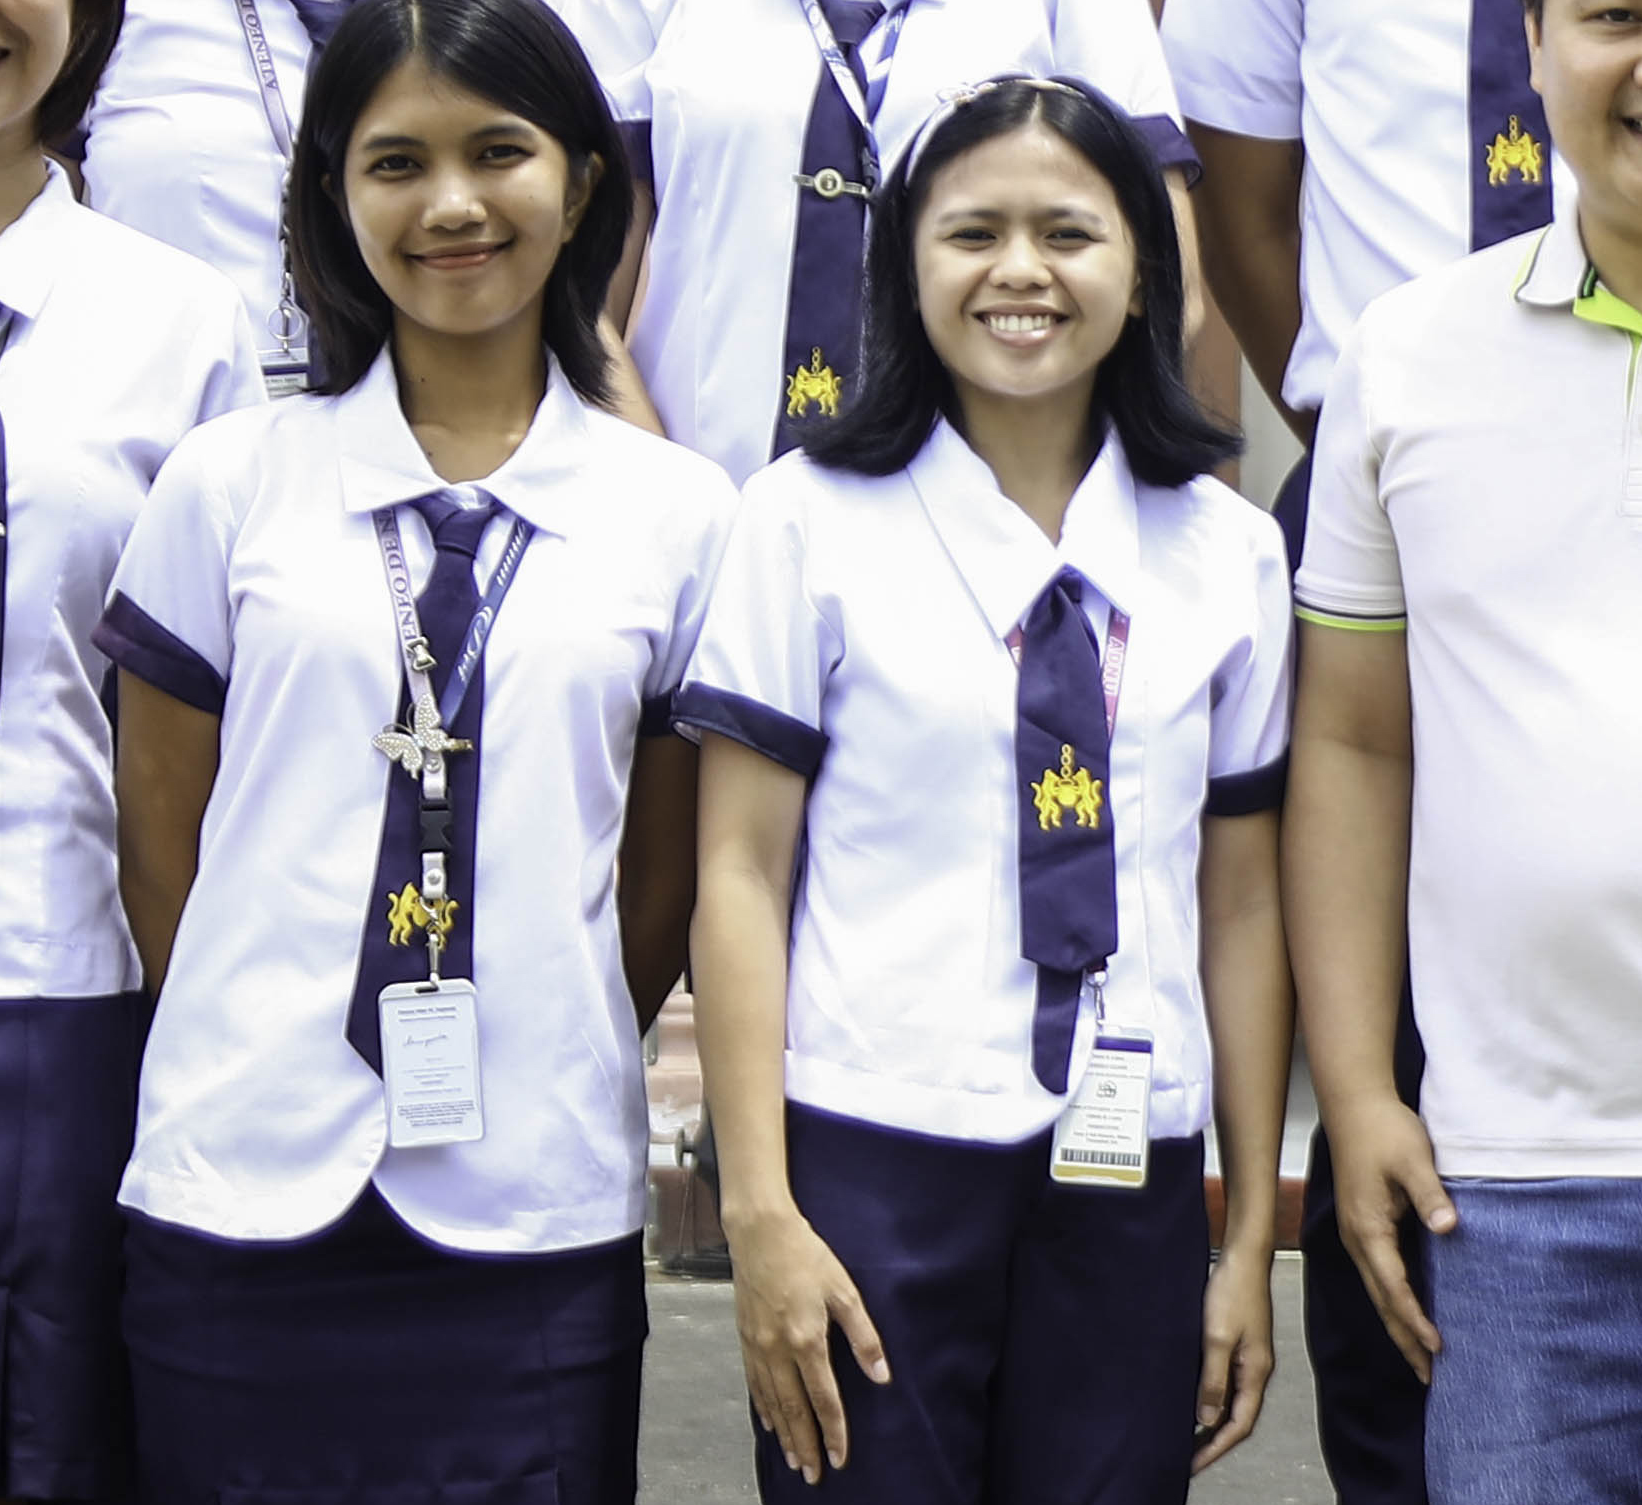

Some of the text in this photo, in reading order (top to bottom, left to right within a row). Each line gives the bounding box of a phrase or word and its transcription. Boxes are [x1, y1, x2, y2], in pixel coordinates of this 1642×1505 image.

[244, 12, 280, 91] ATENEO
[383, 538, 404, 570] DE
[1101, 635, 1127, 697] ADNU
